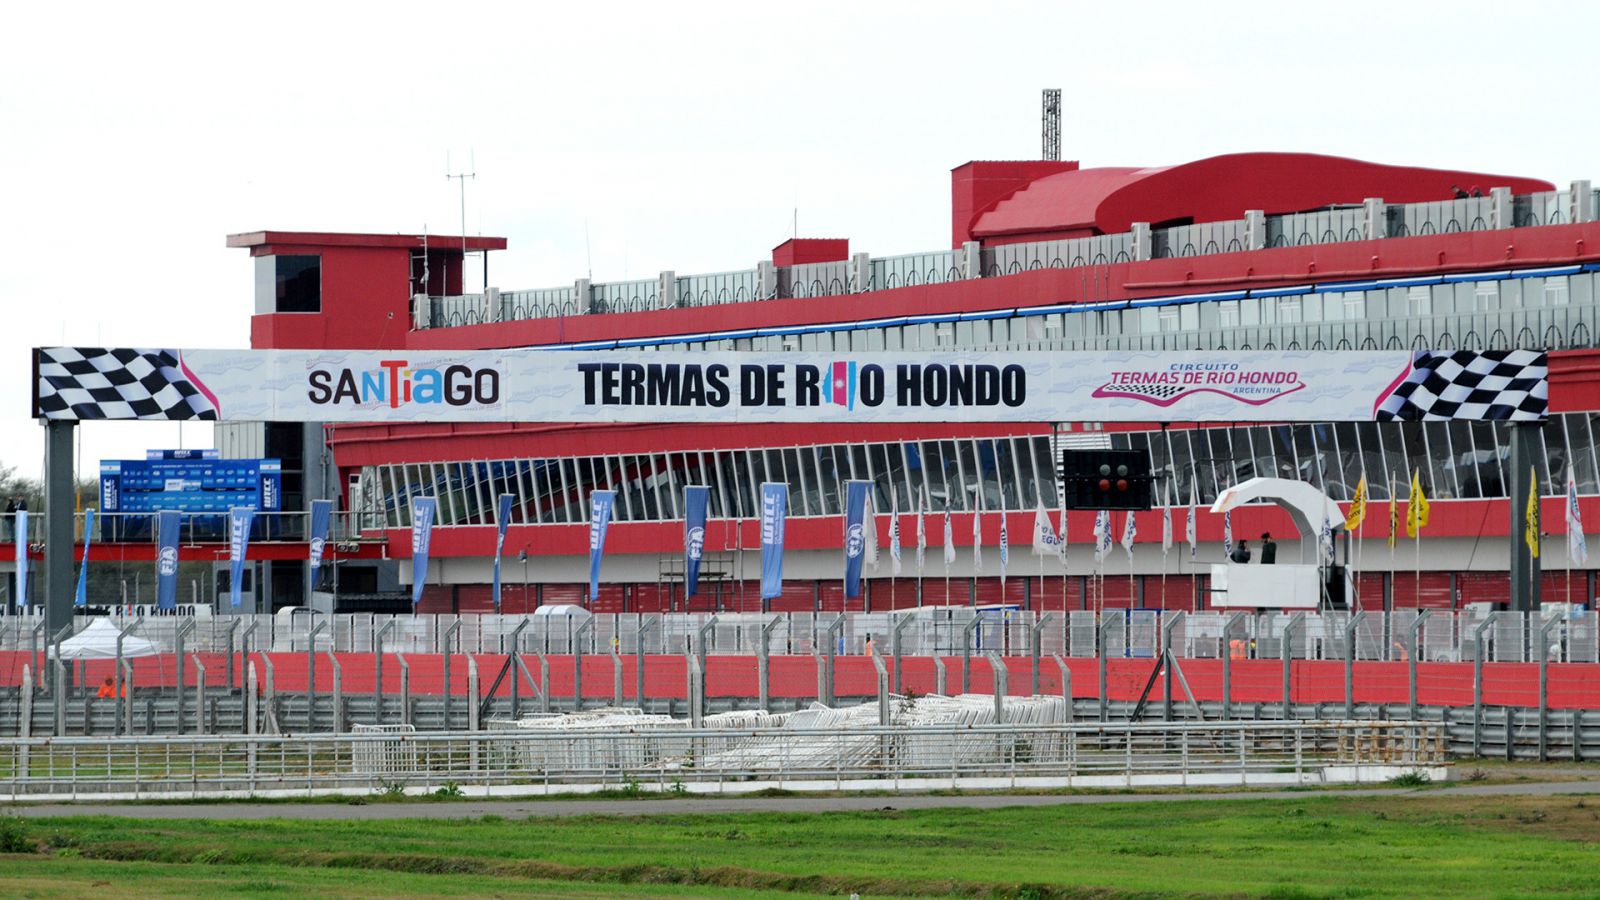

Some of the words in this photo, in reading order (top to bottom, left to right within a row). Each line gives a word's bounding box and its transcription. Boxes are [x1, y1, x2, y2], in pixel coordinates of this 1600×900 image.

[1170, 363, 1240, 371] CIRCUITO
[1111, 372, 1180, 384] TERMAS
[1182, 372, 1201, 384] DE
[1237, 372, 1298, 384] HONDO
[577, 363, 730, 408] TERMAS
[740, 363, 786, 407] DE
[896, 363, 1027, 408] HONDO
[1232, 387, 1282, 395] ARGENTINA
[763, 492, 776, 545] WTCC
